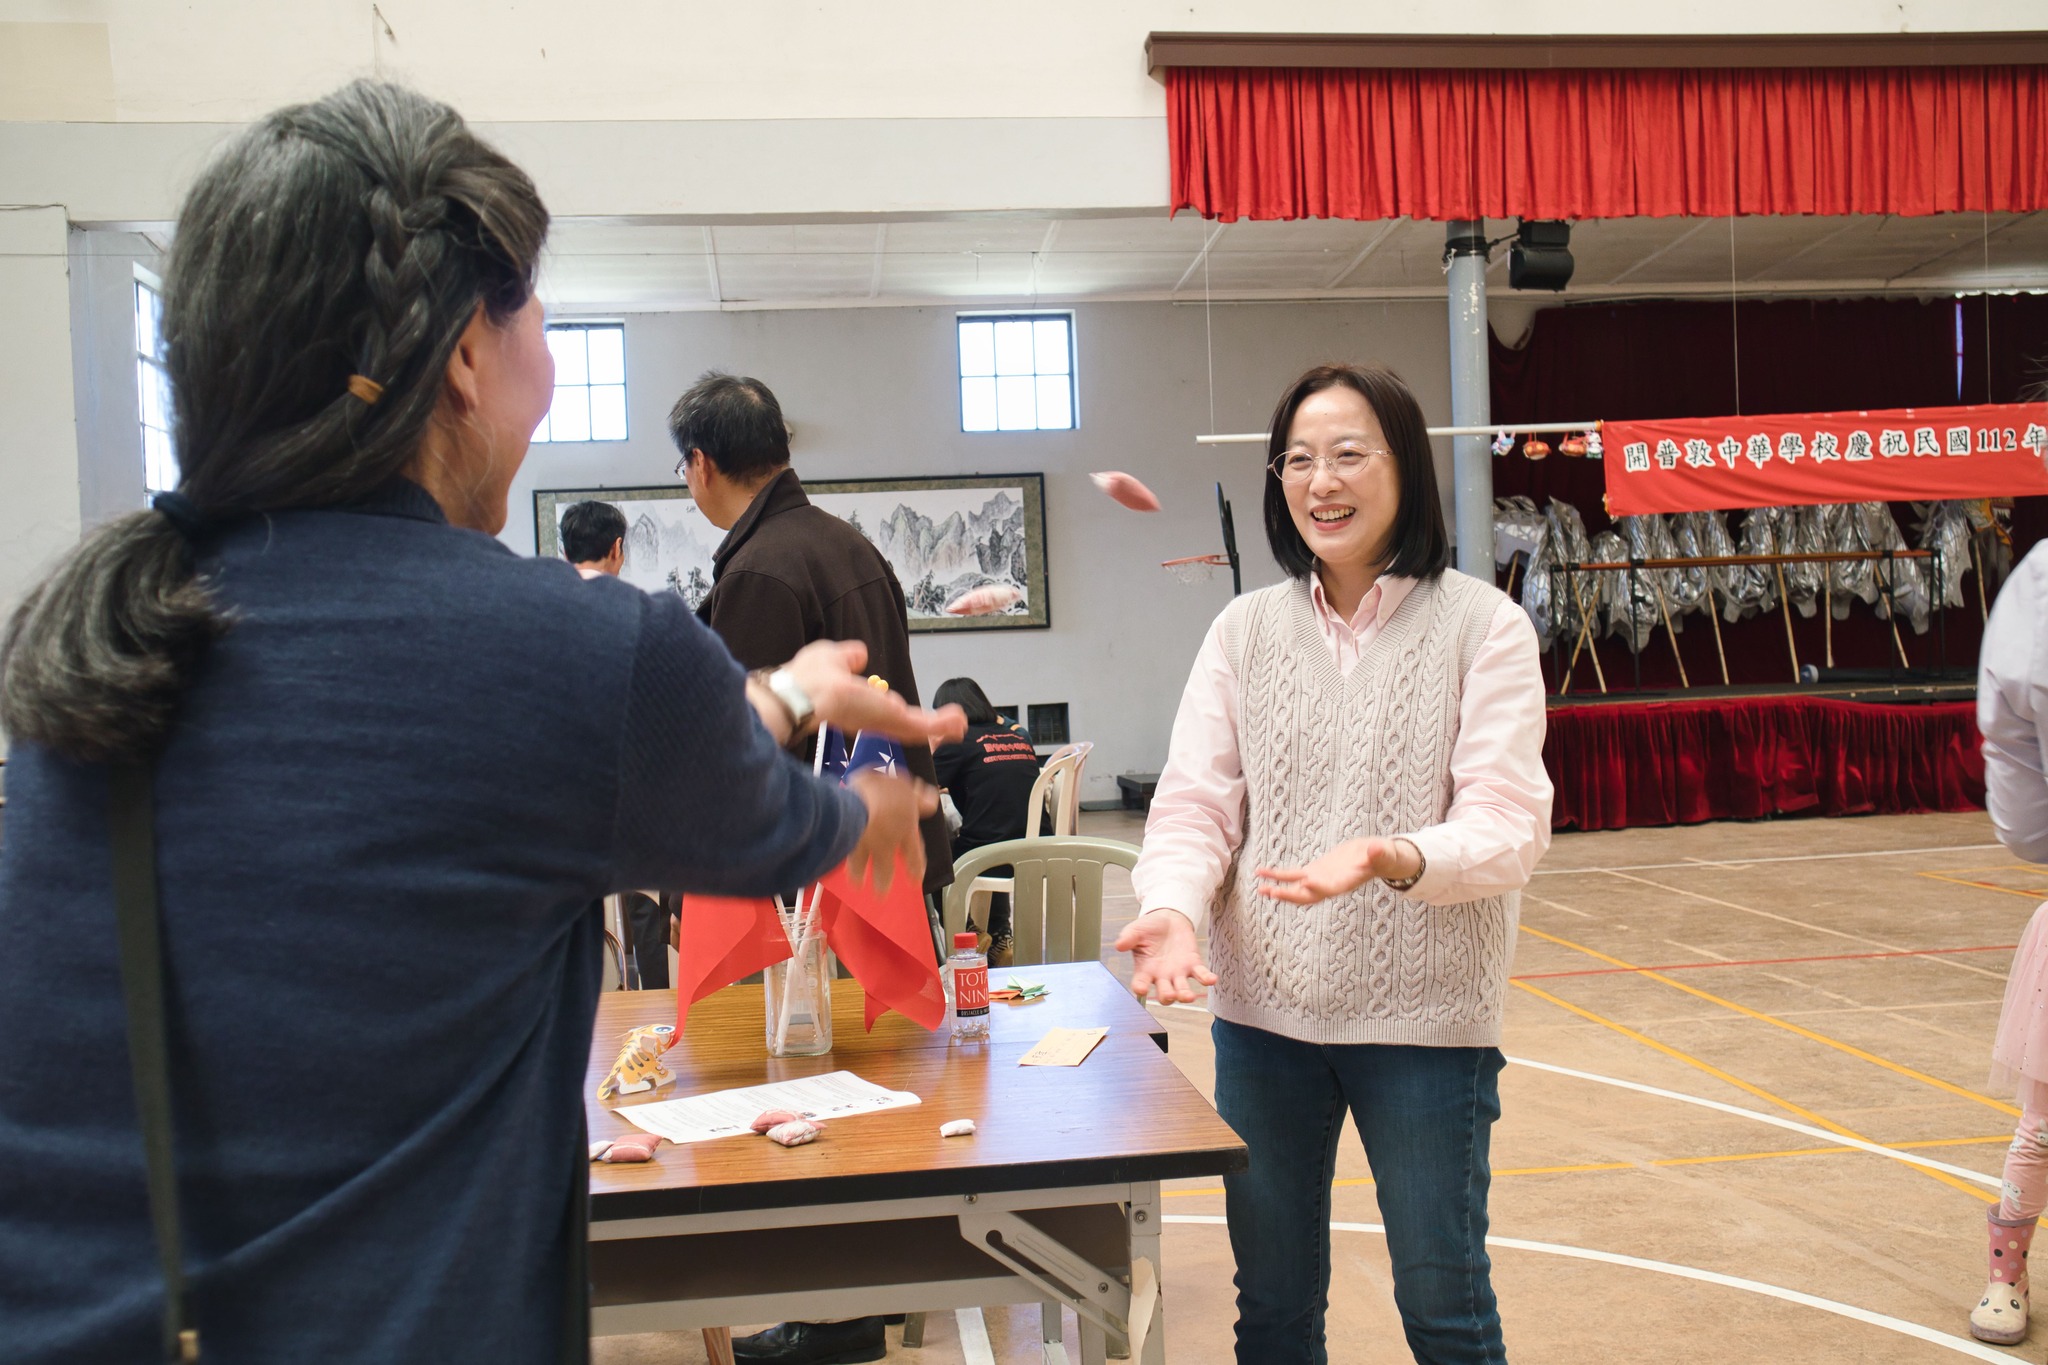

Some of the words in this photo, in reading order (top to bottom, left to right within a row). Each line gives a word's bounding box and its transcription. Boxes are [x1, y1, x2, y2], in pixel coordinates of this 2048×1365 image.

[1624, 424, 2047, 471] 開普敦中華學校慶祝民國112年
